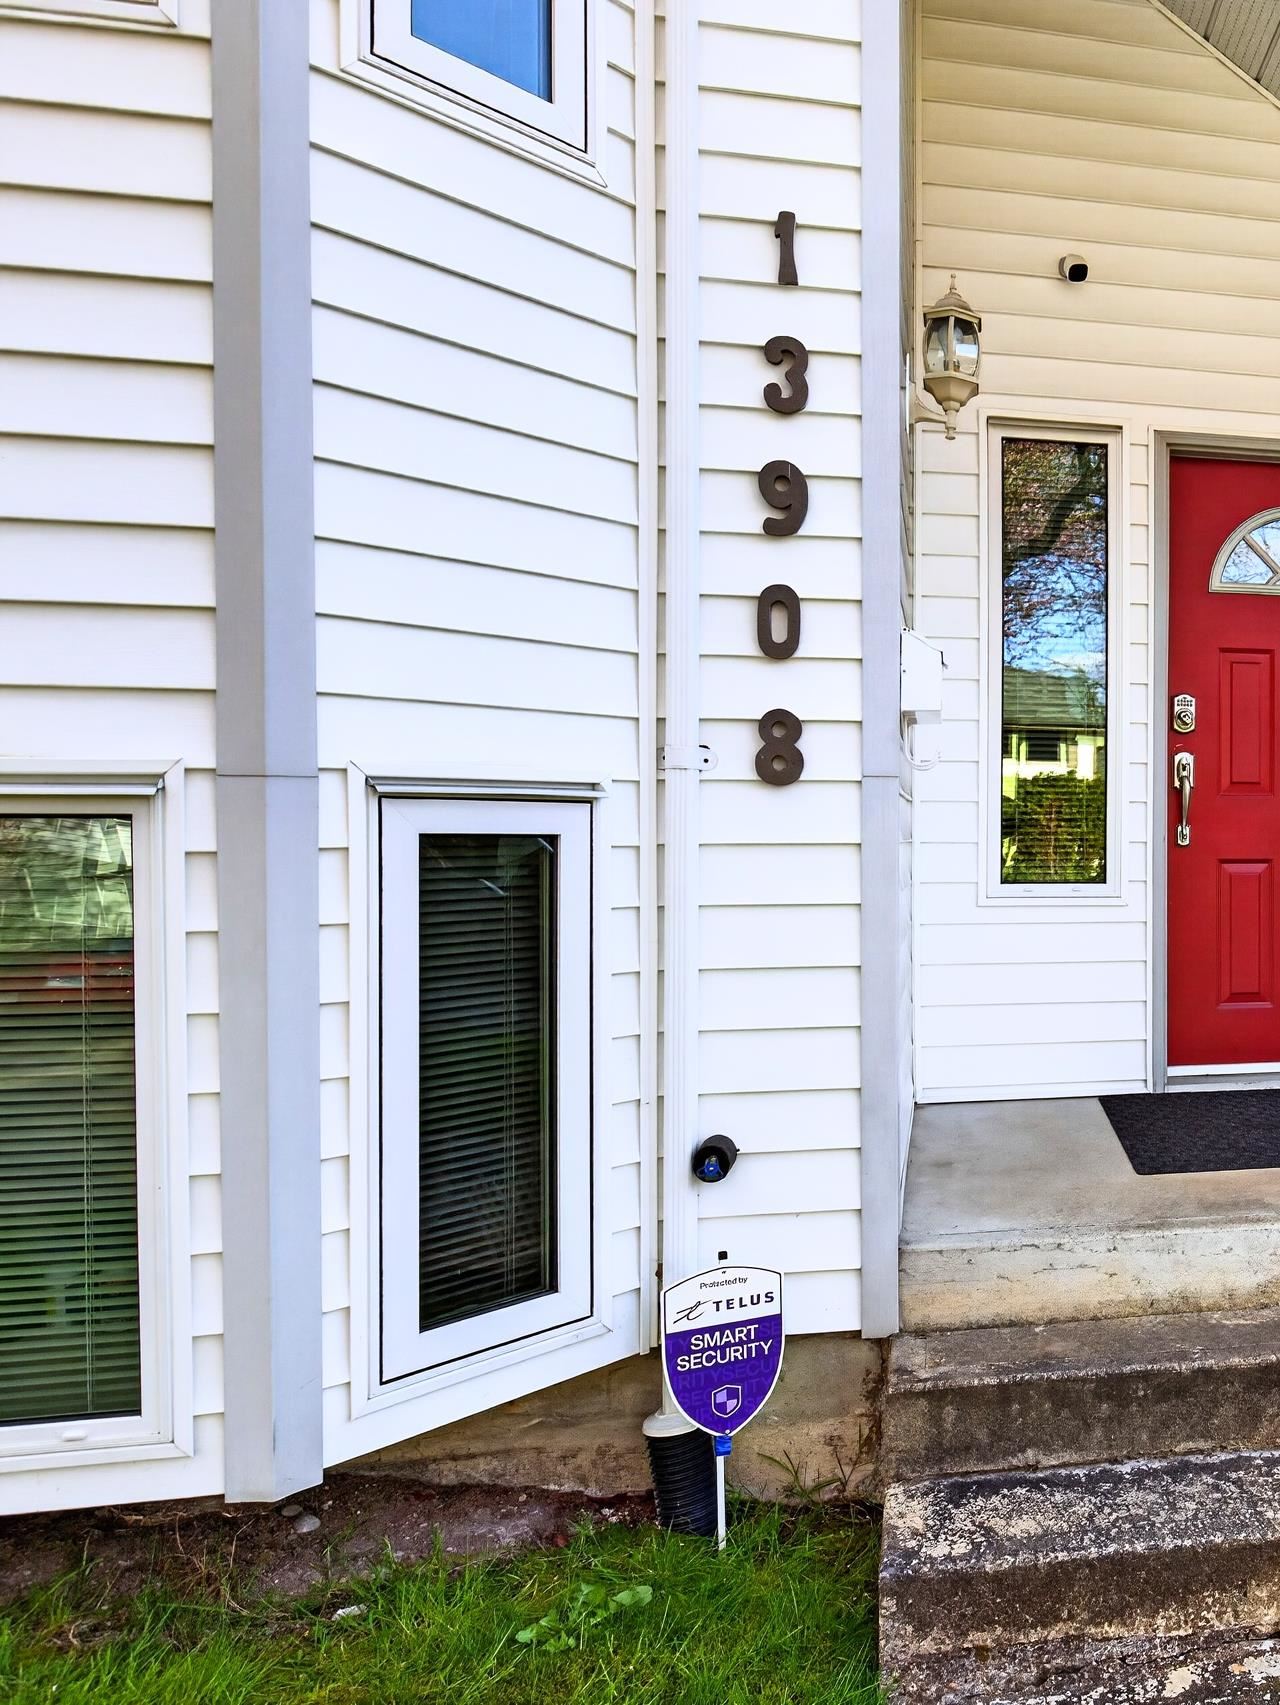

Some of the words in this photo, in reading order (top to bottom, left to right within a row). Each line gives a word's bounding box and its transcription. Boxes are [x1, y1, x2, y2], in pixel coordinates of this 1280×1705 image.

[699, 1277, 737, 1290] Protected
[738, 1276, 749, 1284] by
[712, 1291, 775, 1312] TELUS
[690, 1324, 759, 1351] SMART
[676, 1339, 773, 1372] SECURITY
